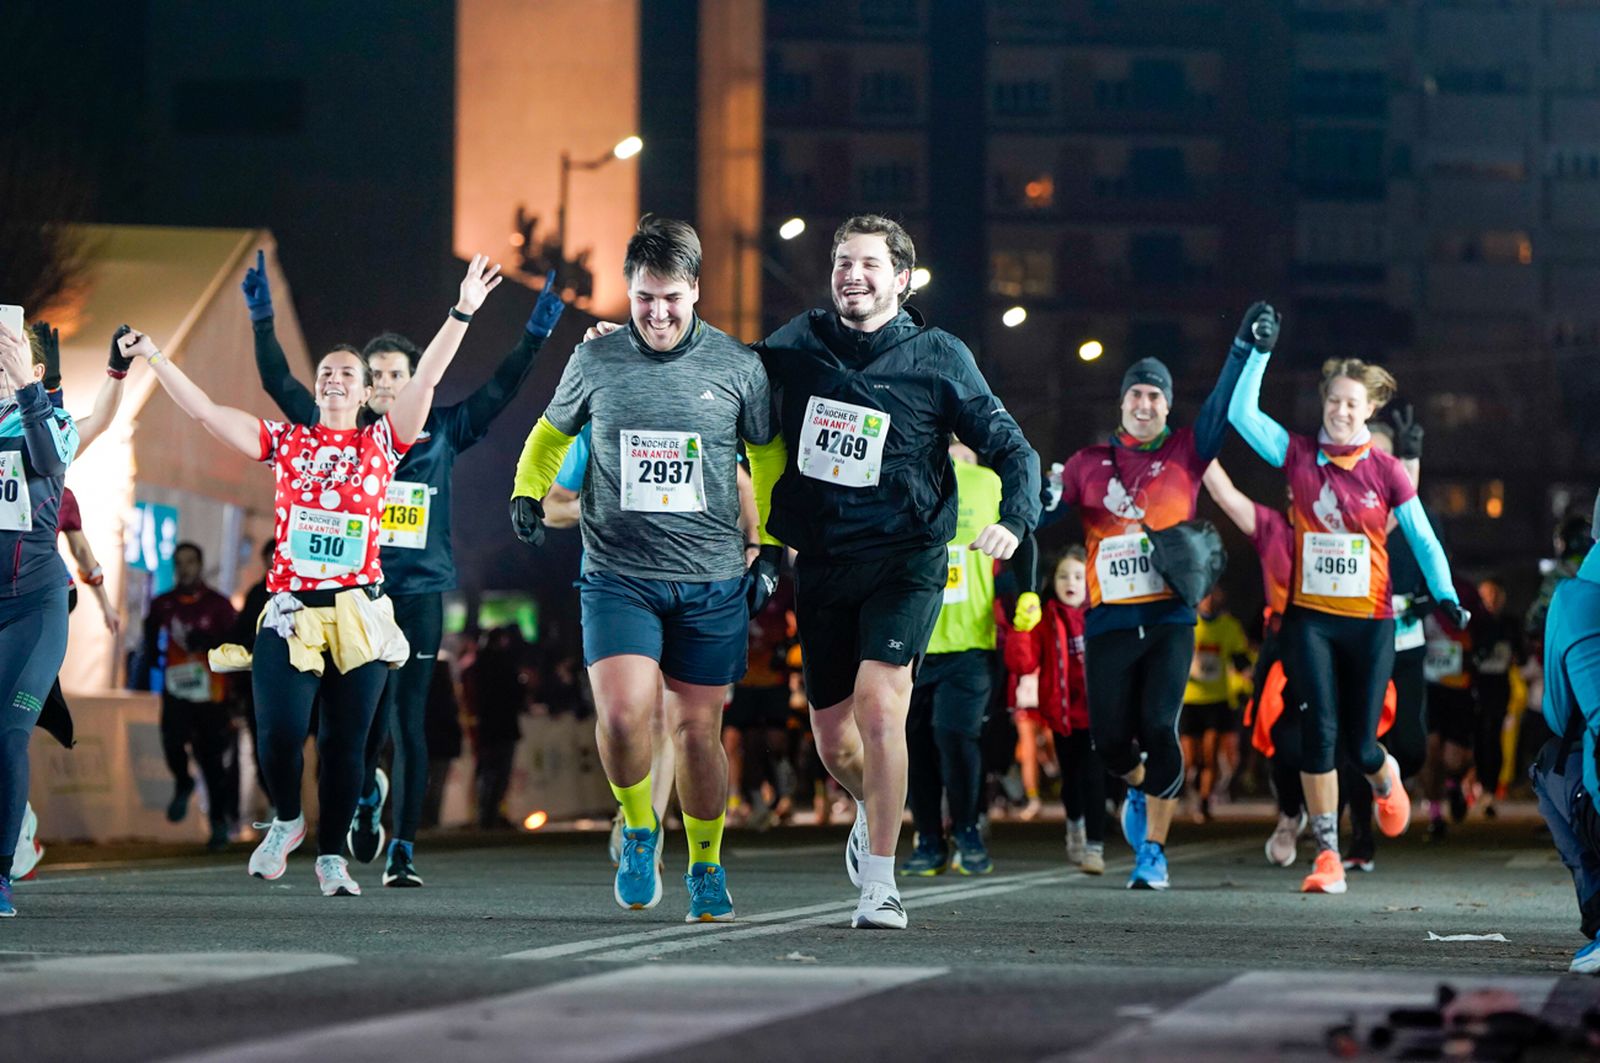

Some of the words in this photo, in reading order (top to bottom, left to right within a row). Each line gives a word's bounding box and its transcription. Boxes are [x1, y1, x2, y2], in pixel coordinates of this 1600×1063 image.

[823, 408, 848, 421] NOCHE
[848, 414, 858, 423] DE
[813, 416, 829, 427] SAN
[830, 420, 856, 433] ANTN
[641, 440, 667, 449] NOCHE
[669, 441, 680, 449] DE
[815, 428, 868, 461] 4269
[631, 449, 648, 459] SAN
[638, 460, 694, 484] 2937
[308, 515, 330, 525] NOCHE
[381, 505, 418, 525] 136
[298, 522, 313, 531] SAN
[309, 534, 345, 557] 510
[1110, 556, 1150, 577] 4970
[1314, 556, 1357, 574] 4969
